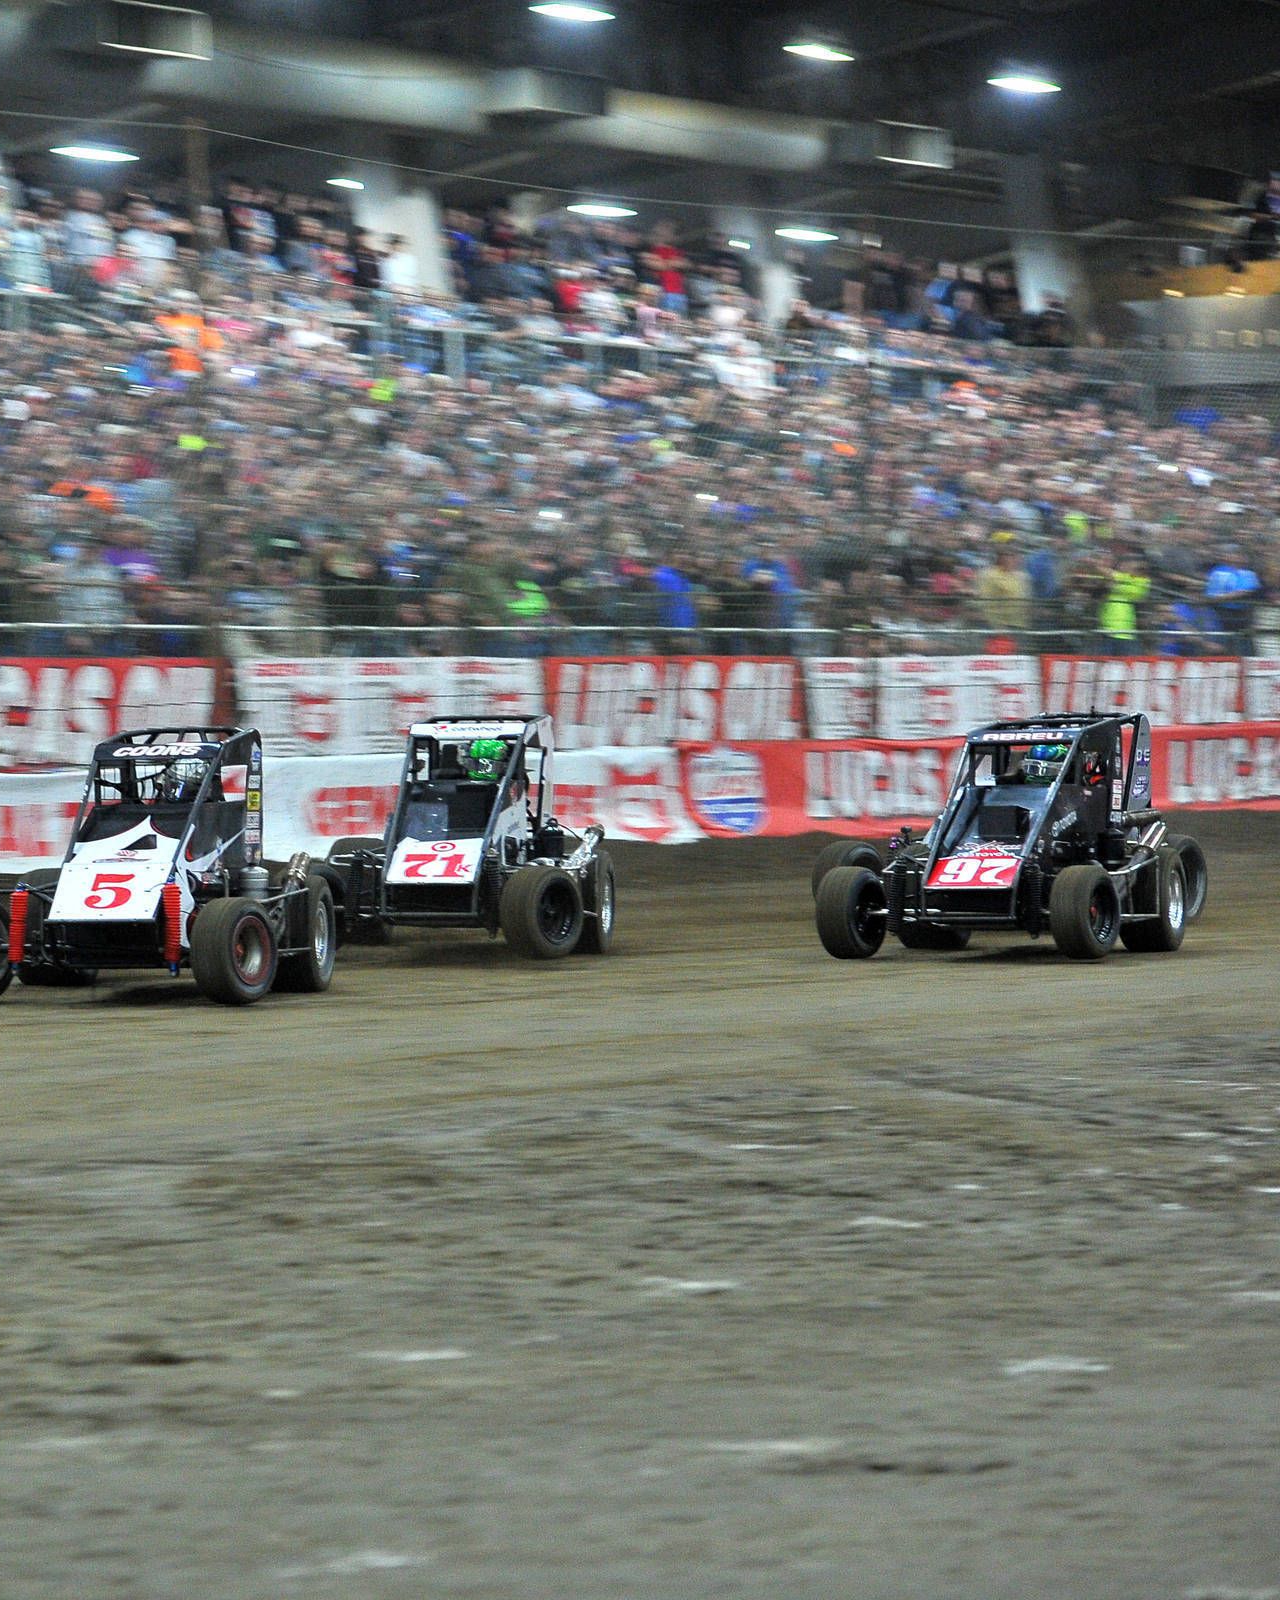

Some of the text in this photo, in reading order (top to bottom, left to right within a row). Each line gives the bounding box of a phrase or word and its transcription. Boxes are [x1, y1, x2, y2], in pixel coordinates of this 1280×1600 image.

[982, 731, 1064, 742] ABREU
[111, 744, 202, 757] COONS
[937, 857, 1018, 885] 97
[83, 873, 136, 909] 5
